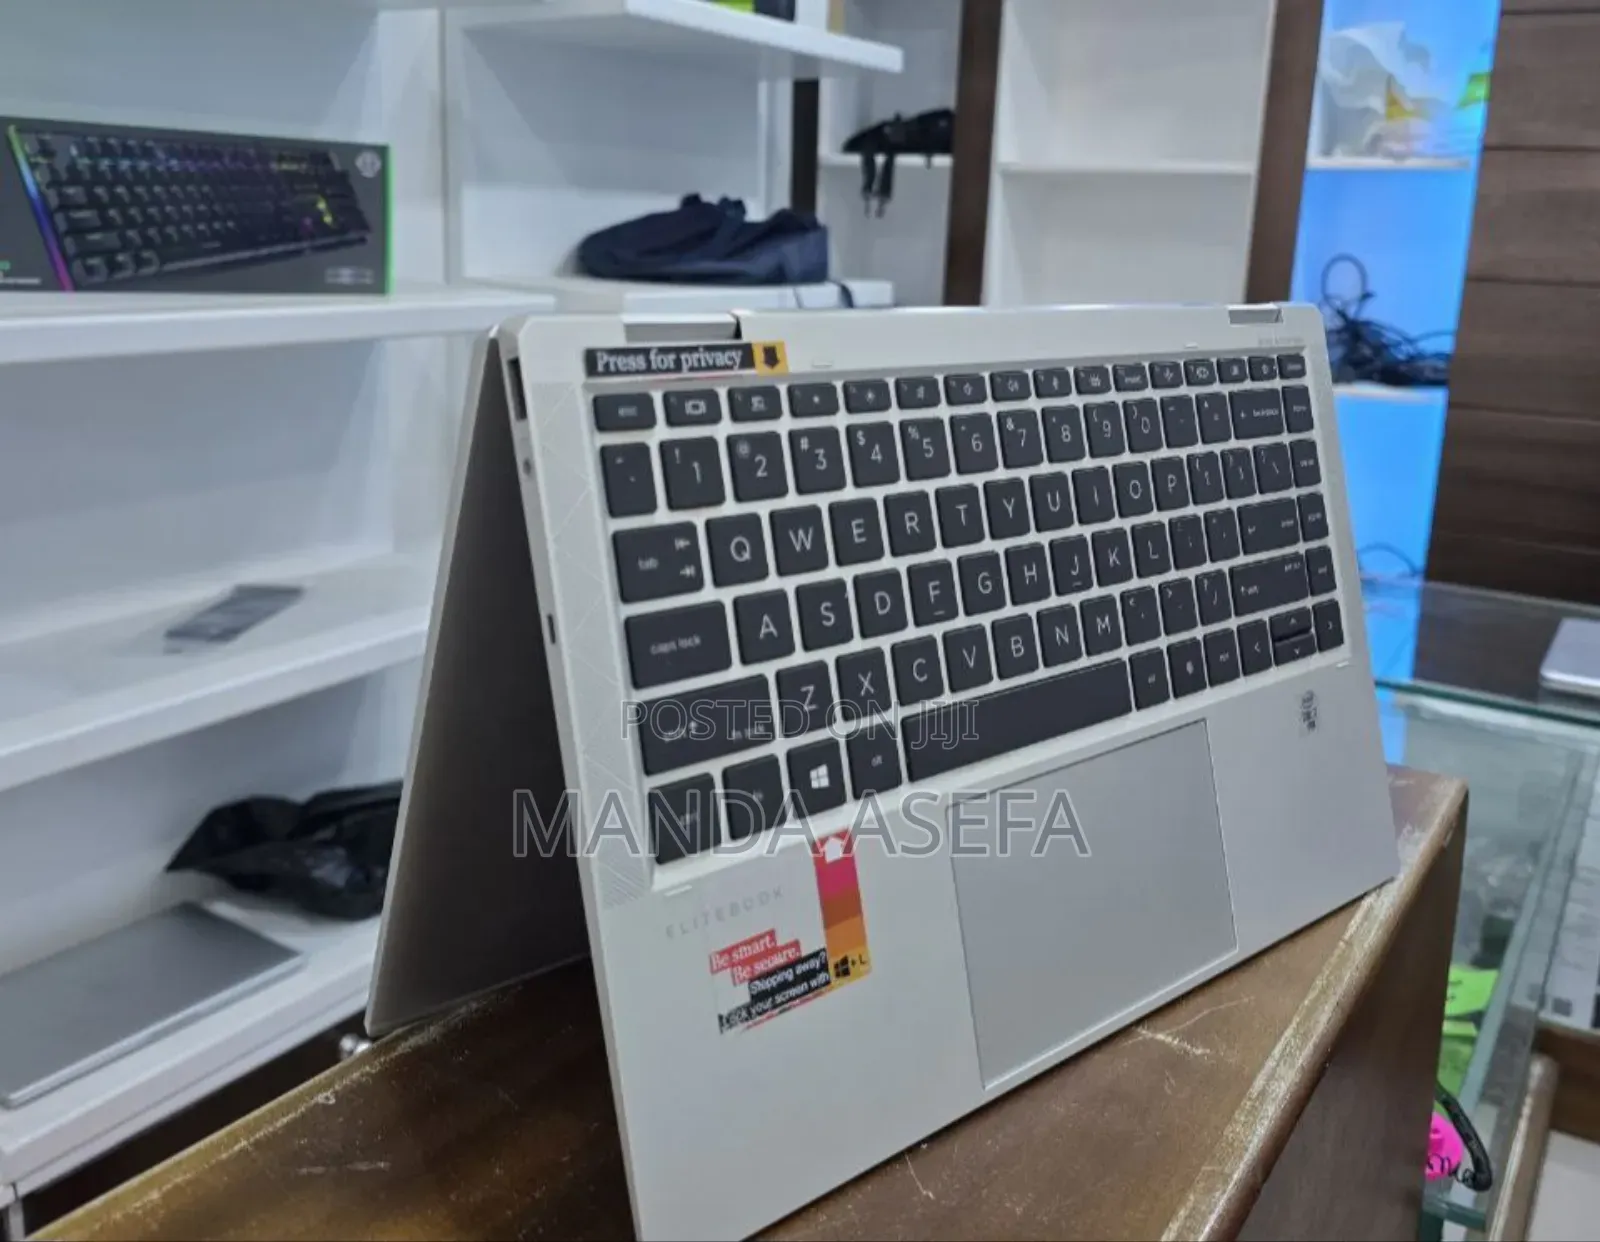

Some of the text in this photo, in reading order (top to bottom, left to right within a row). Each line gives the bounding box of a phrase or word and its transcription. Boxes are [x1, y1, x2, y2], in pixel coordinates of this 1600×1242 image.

[597, 345, 743, 374] Press for privacy
[908, 426, 919, 439] %
[1007, 418, 1014, 430] &
[1062, 425, 1071, 442] 8
[1103, 420, 1111, 437] 9
[800, 437, 808, 450] #
[857, 430, 865, 445] $
[923, 438, 934, 458] 5
[972, 434, 982, 451] 6
[1018, 429, 1026, 447] 7
[815, 448, 827, 470] 3
[871, 444, 882, 462] 4
[693, 462, 701, 482] 1
[755, 455, 767, 477] 2
[1130, 480, 1142, 499] O
[1168, 474, 1176, 492] P
[1003, 498, 1014, 518] Y
[1047, 491, 1060, 512] U
[905, 512, 919, 534] R
[956, 504, 967, 525] T
[789, 528, 812, 552] W
[852, 519, 866, 543] E
[730, 536, 751, 562] Q
[1109, 548, 1120, 566] K
[1148, 540, 1159, 559] L
[1024, 564, 1037, 584] H
[1071, 555, 1079, 575] J
[929, 581, 940, 603] F
[978, 572, 992, 594] G
[875, 591, 891, 615] D
[821, 602, 835, 626] S
[1097, 615, 1110, 633] M
[760, 614, 777, 639] A
[1055, 626, 1069, 645] N
[679, 634, 700, 650] lock
[1011, 636, 1024, 657] B
[963, 646, 975, 668] V
[913, 658, 927, 682] C
[858, 672, 874, 696] X
[801, 685, 817, 711] Z
[665, 886, 785, 940] ELITEBOOK
[732, 935, 775, 961] smart.
[733, 946, 799, 983] Be secure.
[858, 953, 867, 967] L
[774, 982, 809, 1003] screen
[809, 970, 830, 989] with
